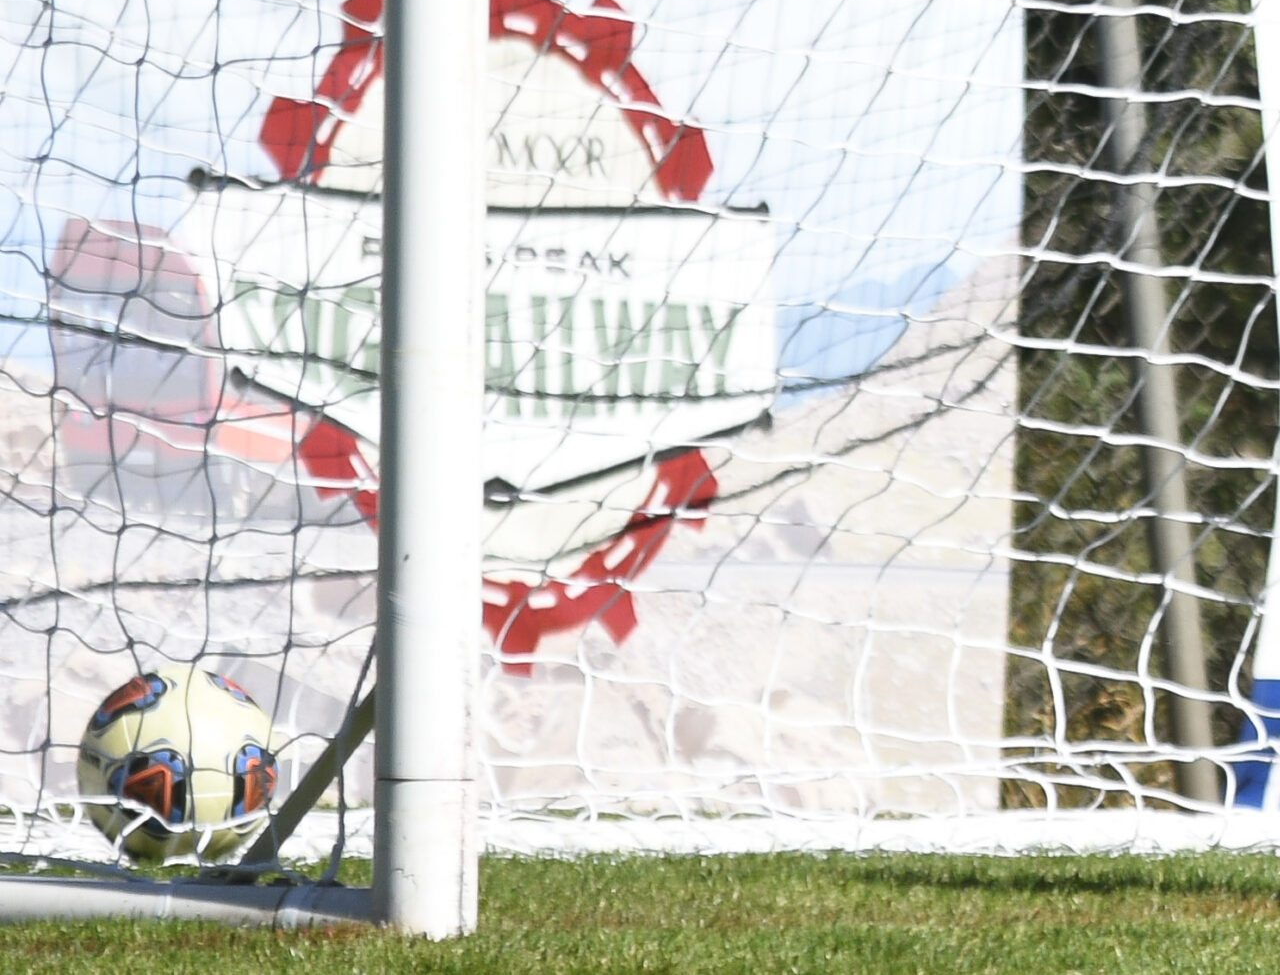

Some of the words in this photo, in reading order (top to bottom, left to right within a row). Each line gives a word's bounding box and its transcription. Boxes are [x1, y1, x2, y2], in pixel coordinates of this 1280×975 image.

[492, 131, 608, 177] MOOR
[514, 246, 630, 278] PEAK
[485, 292, 744, 418] AILWAY
